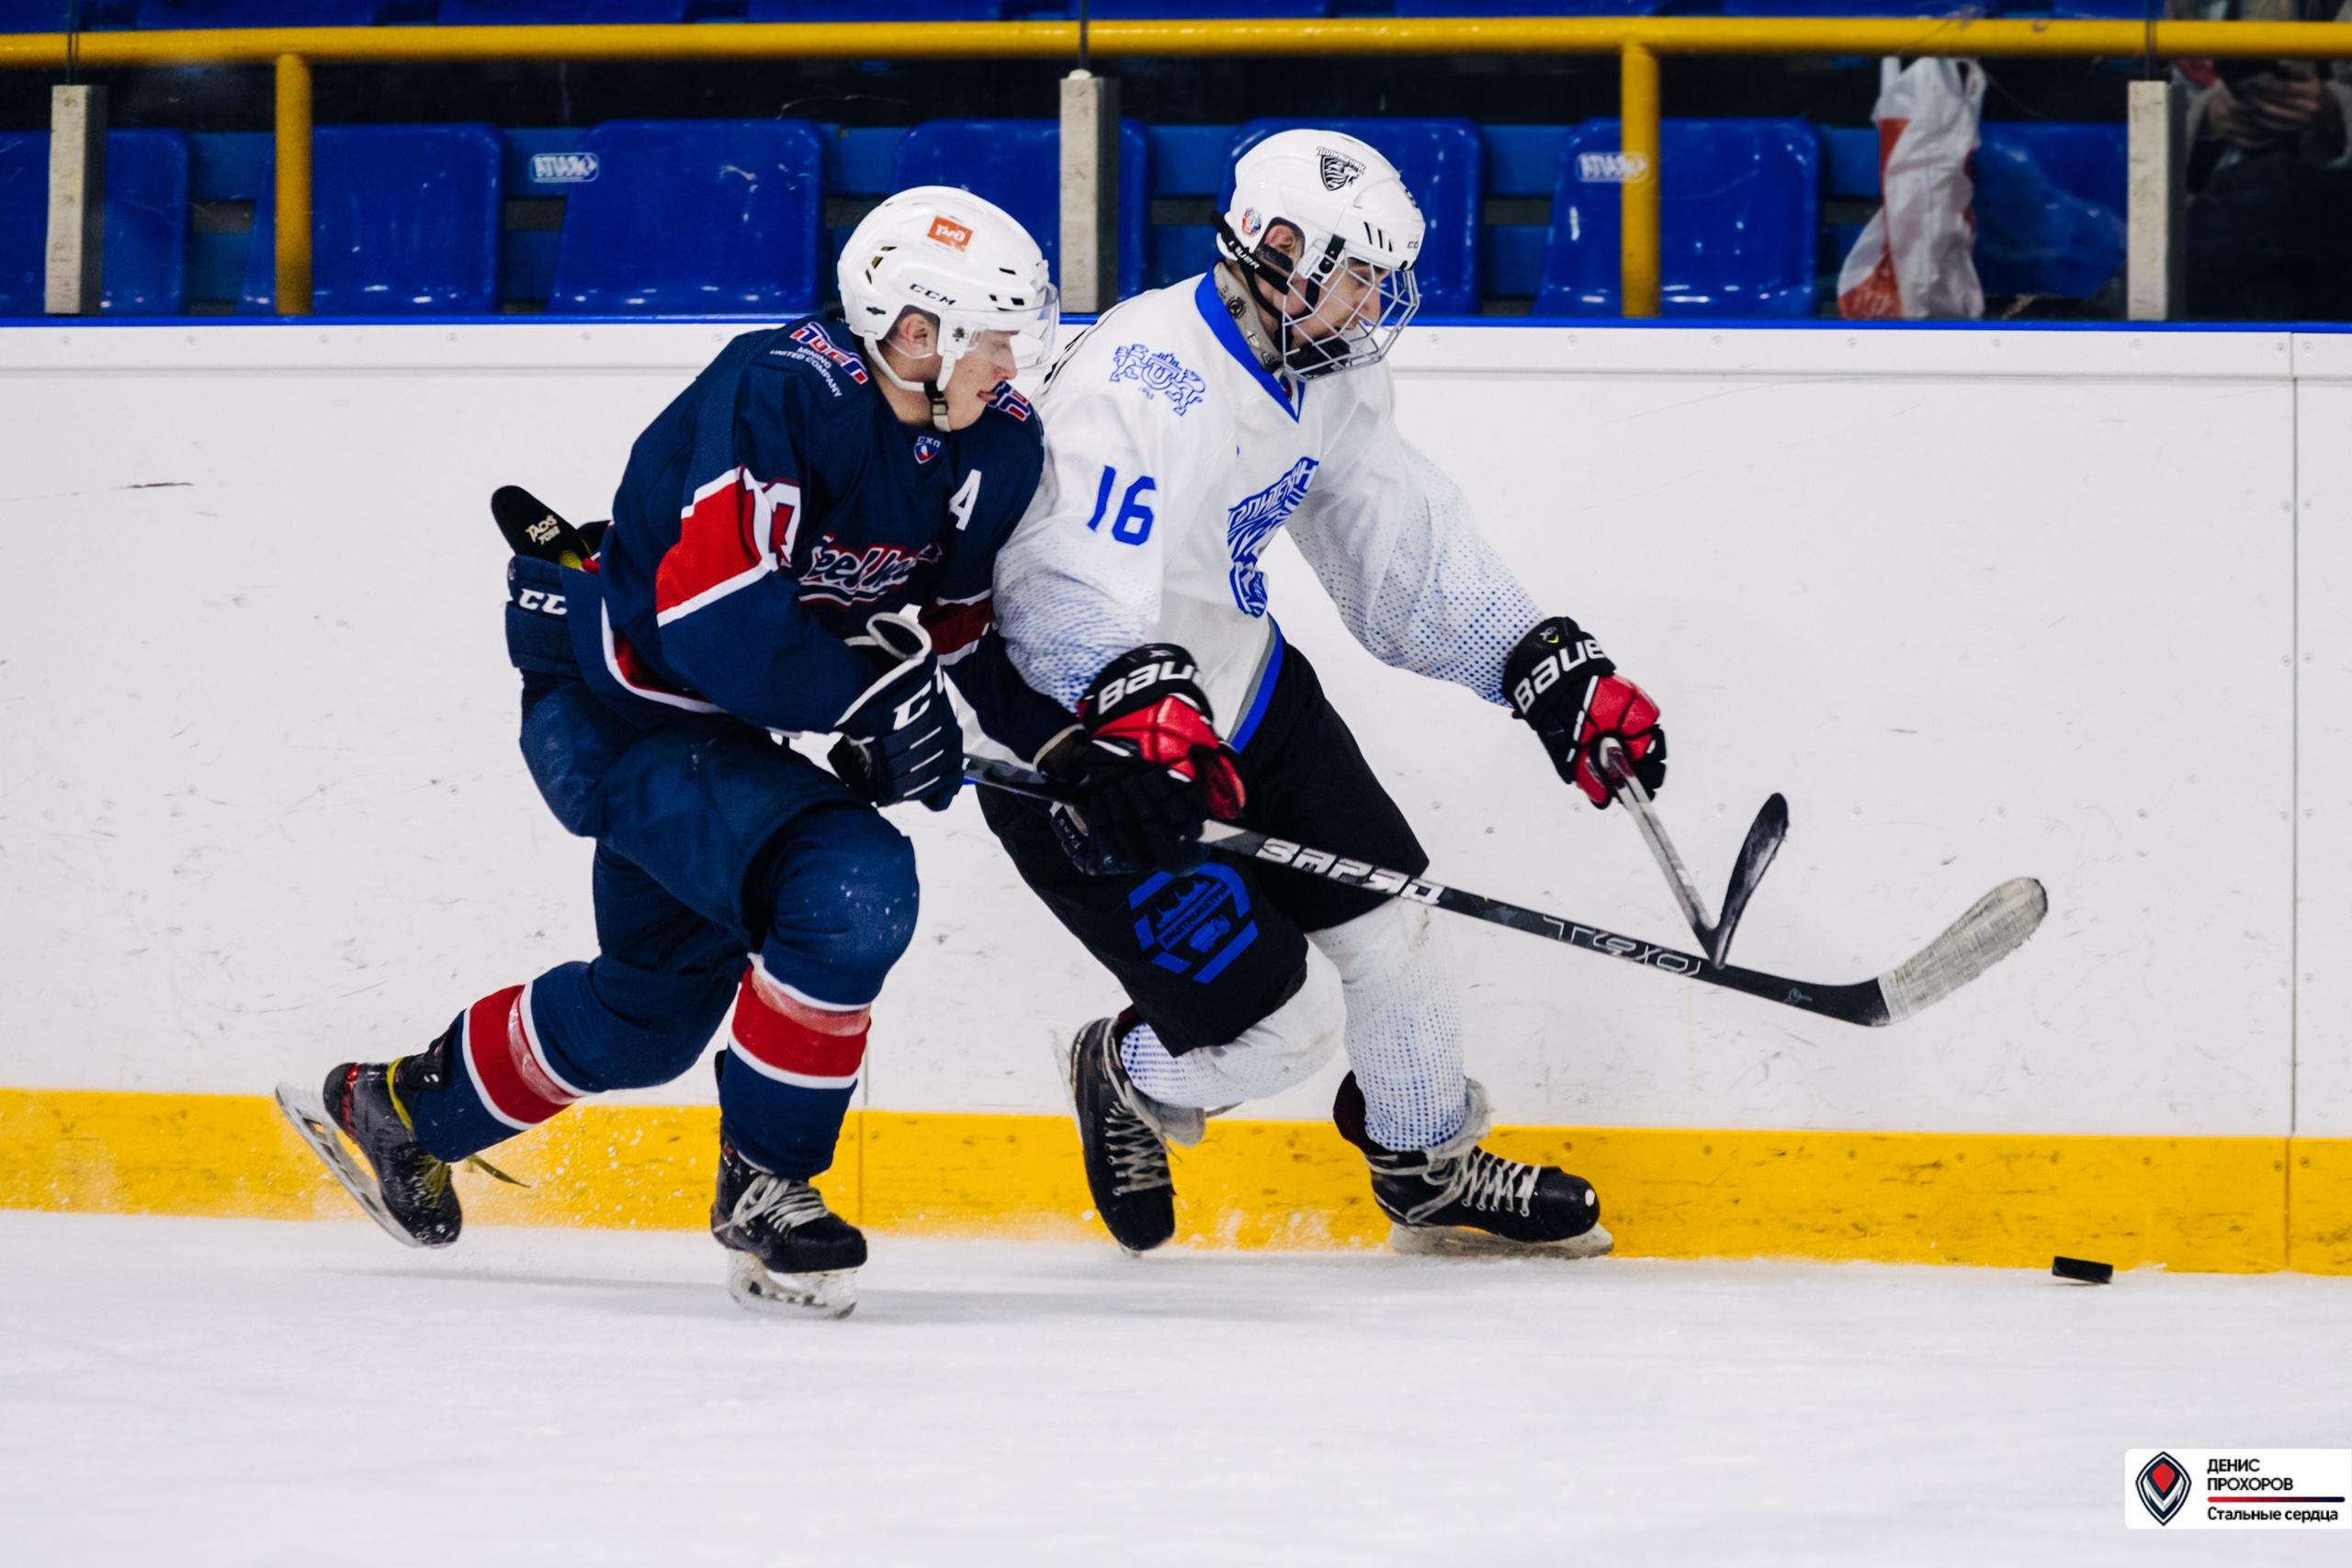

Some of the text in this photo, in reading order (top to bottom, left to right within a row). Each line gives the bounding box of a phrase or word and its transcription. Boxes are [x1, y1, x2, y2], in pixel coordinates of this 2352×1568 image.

[910, 283, 956, 306] CCM
[770, 350, 806, 364] UNITED
[805, 355, 842, 397] COMPANY
[797, 346, 832, 369] MINING
[948, 468, 982, 531] A
[1086, 464, 1157, 546] 16
